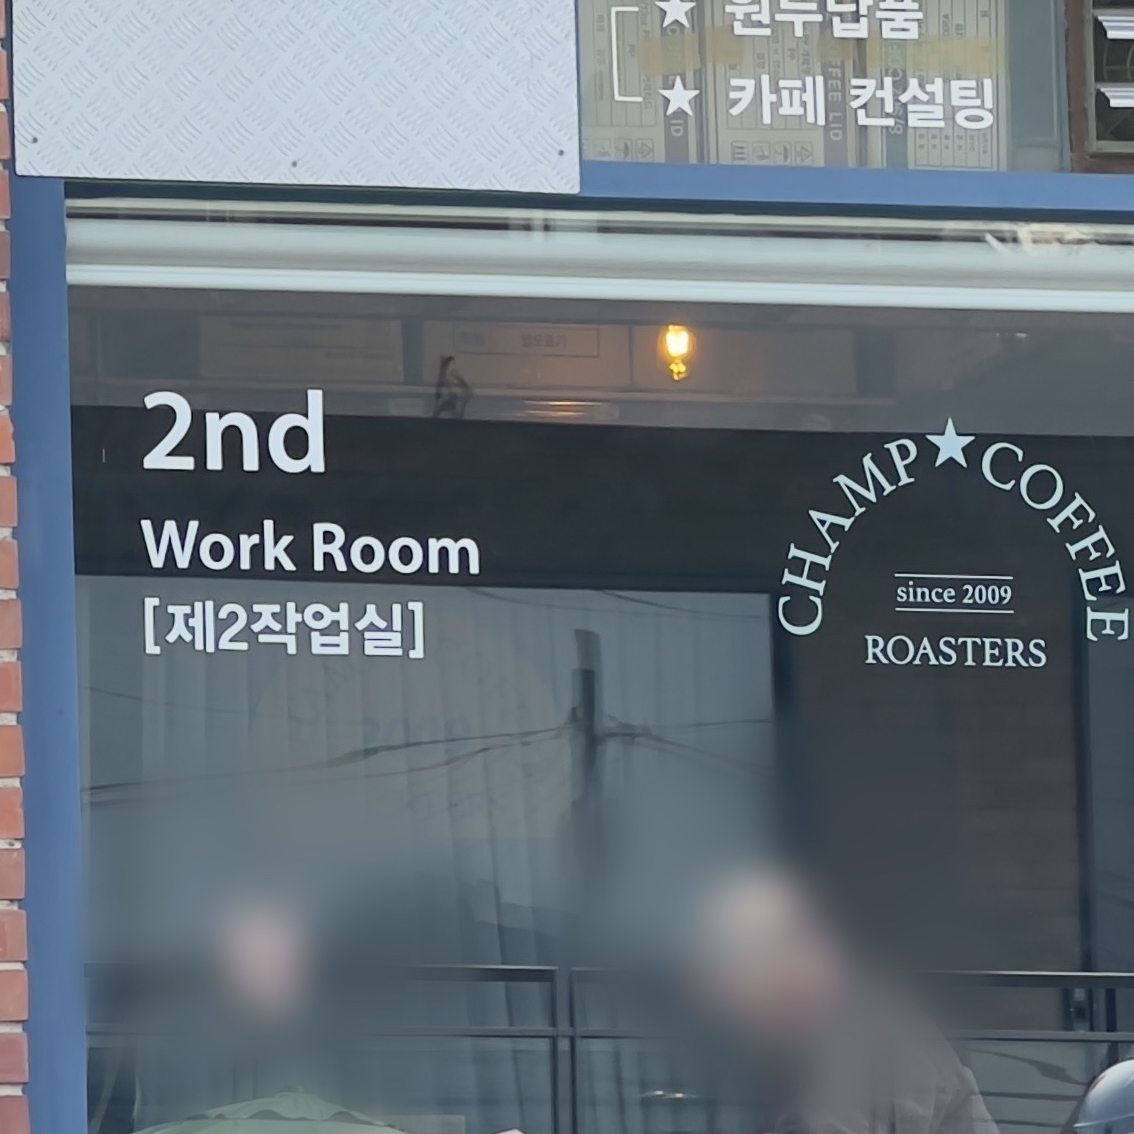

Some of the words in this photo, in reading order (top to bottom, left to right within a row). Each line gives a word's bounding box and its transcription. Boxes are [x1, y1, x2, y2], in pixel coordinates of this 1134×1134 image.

[728, 74, 826, 126] 카페
[849, 76, 994, 130] 컨설팅
[142, 388, 326, 474] 2nd
[140, 518, 297, 572] Work
[312, 521, 481, 575] Room
[778, 438, 918, 636] CHAMP
[981, 442, 1129, 642] COFFEE
[896, 580, 956, 603] since
[961, 585, 1013, 605] 2009
[143, 596, 425, 659] [제2작업실]
[864, 634, 1048, 668] ROASTERS
